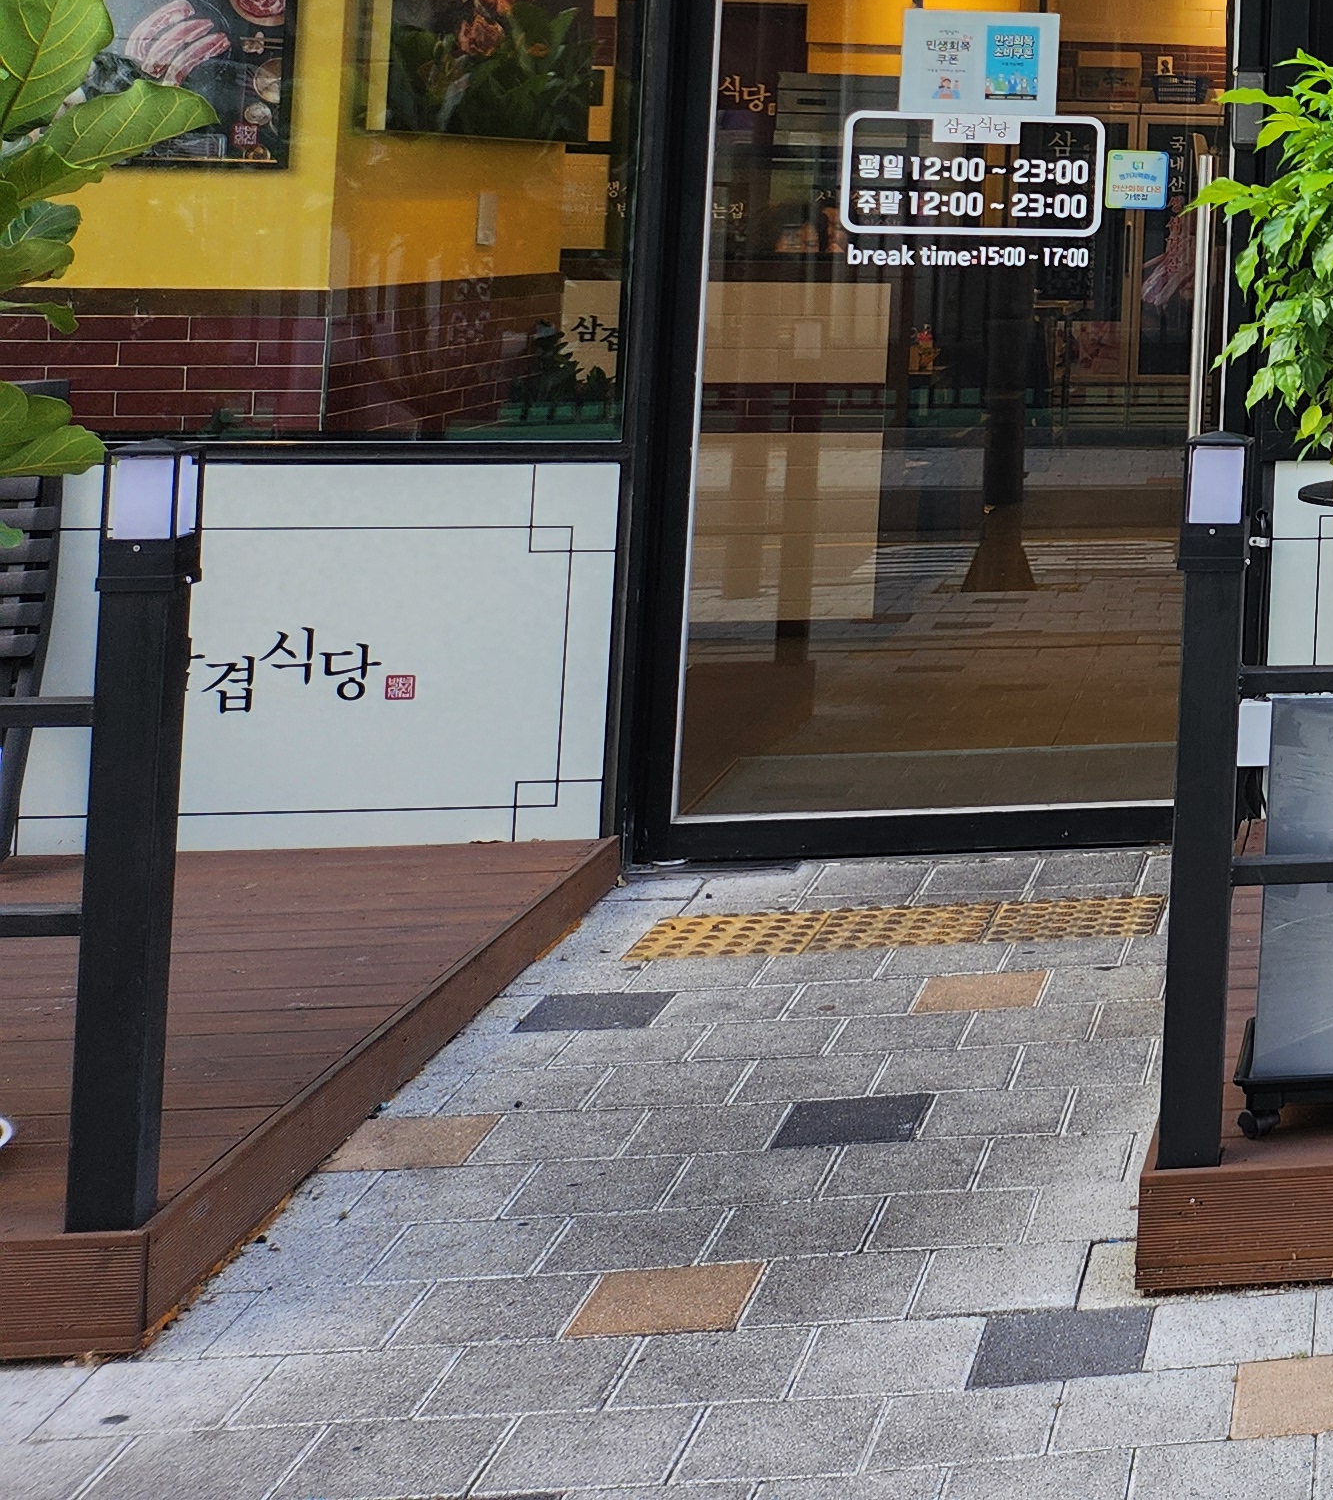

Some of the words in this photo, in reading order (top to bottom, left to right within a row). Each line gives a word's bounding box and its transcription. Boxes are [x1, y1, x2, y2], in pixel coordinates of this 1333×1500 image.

[944, 116, 1010, 141] 삼겹식당
[858, 154, 904, 179] 평일
[910, 156, 985, 182] 12:00
[1013, 159, 1089, 184] 23:00
[857, 190, 903, 215] 주말
[909, 191, 984, 217] 12:00
[1011, 193, 1087, 218] 23:00
[847, 244, 915, 266] break
[1043, 247, 1089, 267] 17:00
[186, 626, 382, 714] 겹식당
